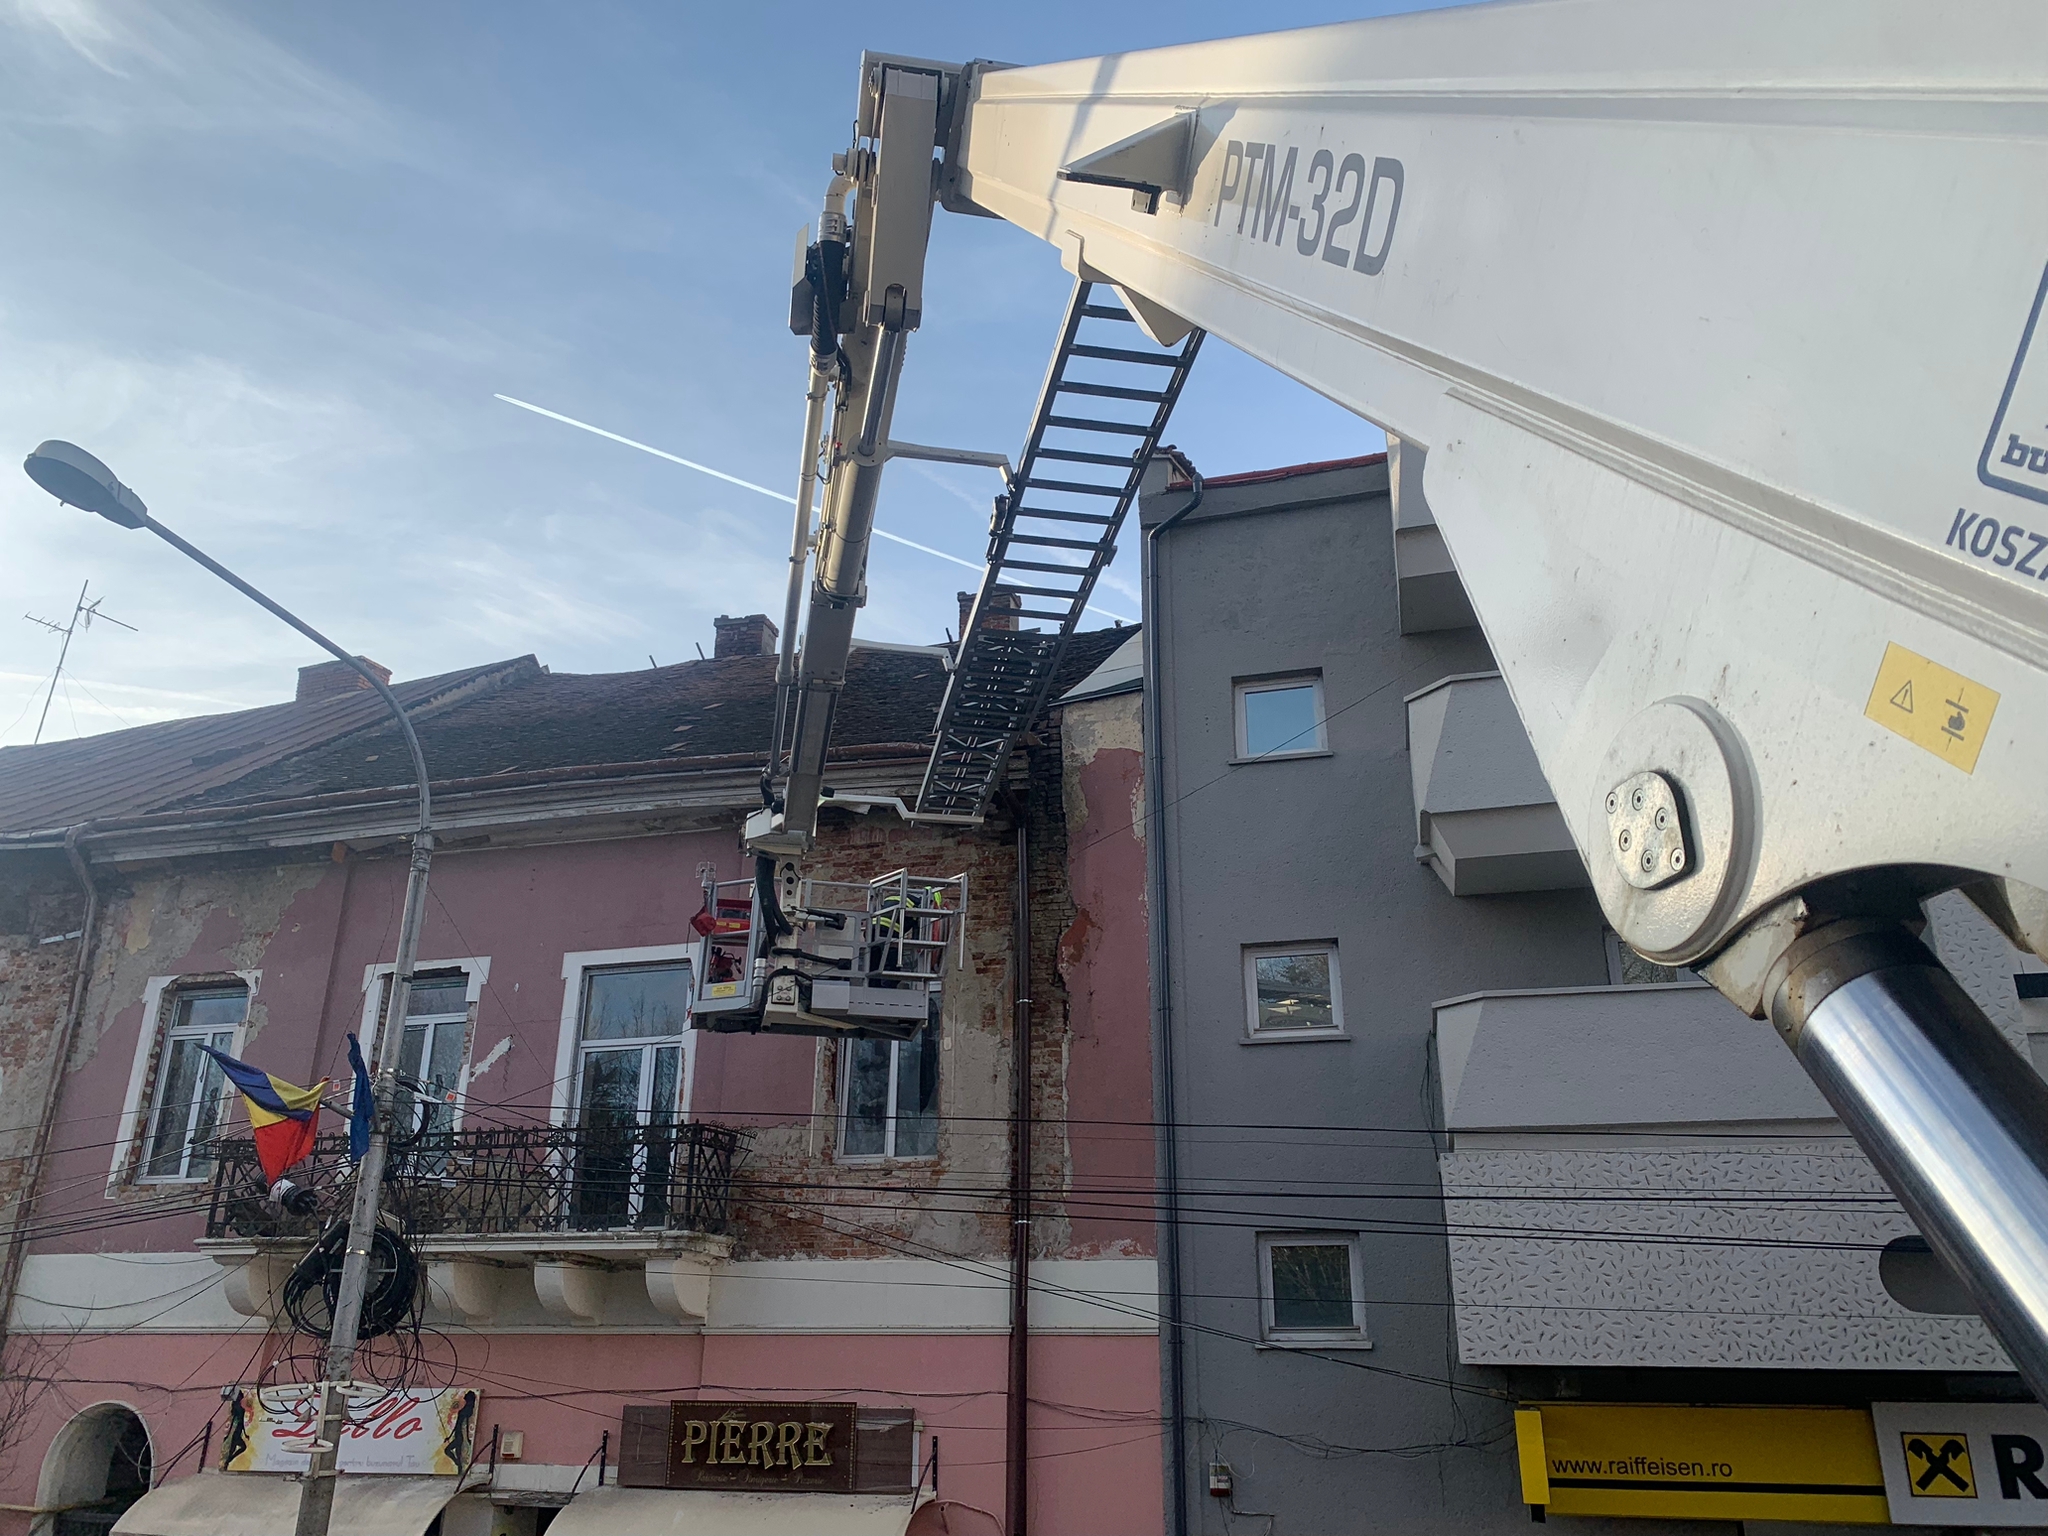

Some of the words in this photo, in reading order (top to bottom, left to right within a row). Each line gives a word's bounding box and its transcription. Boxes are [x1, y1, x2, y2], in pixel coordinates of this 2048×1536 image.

[1214, 140, 1404, 276] PTM-32D
[1946, 508, 2048, 581] KOSZ
[681, 1420, 834, 1470] PIERRE
[1552, 1456, 1732, 1477] www.raiffeisen.ro
